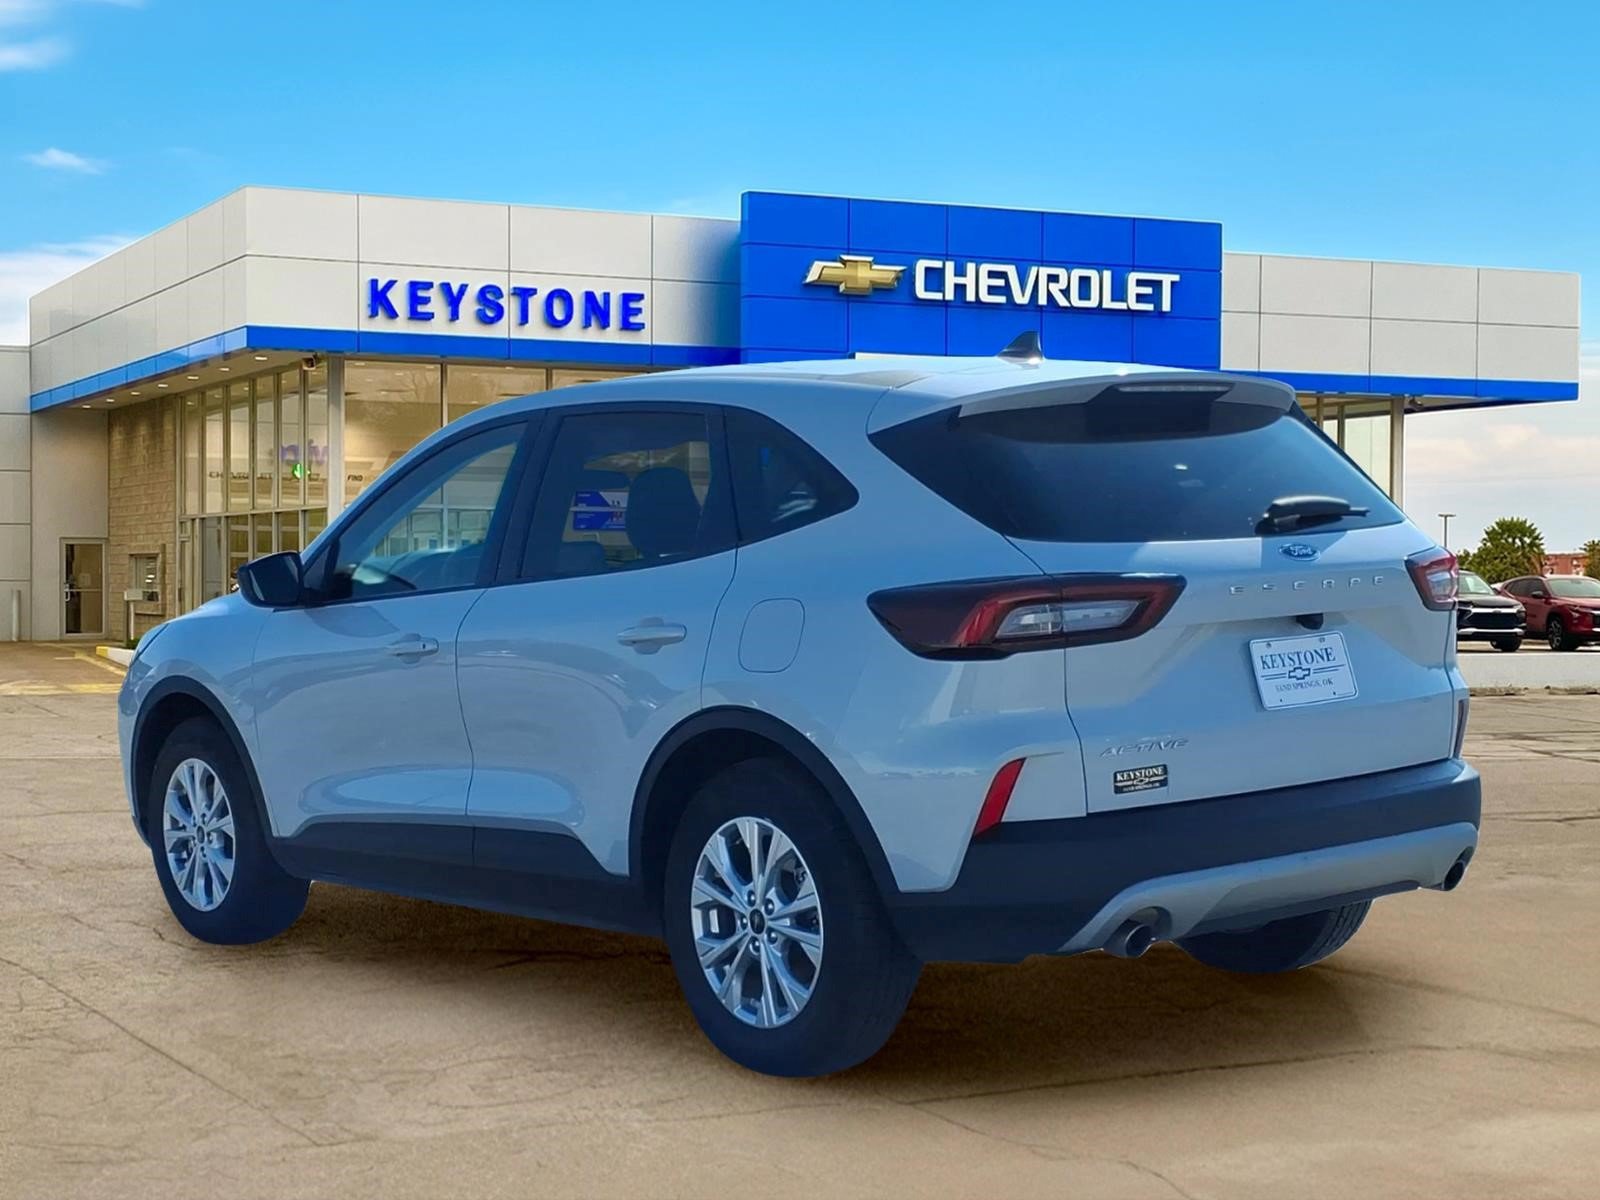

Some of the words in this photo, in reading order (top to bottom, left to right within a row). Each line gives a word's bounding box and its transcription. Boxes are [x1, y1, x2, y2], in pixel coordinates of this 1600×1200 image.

[914, 258, 1181, 313] CHEVROLET
[367, 277, 646, 332] KEYSTONE
[1230, 575, 1384, 594] ESCAPE
[1260, 646, 1336, 670] KEYSTONE
[1322, 677, 1334, 687] OK
[1099, 738, 1190, 757] ACTIVE
[1115, 766, 1165, 781] KEYSTONE
